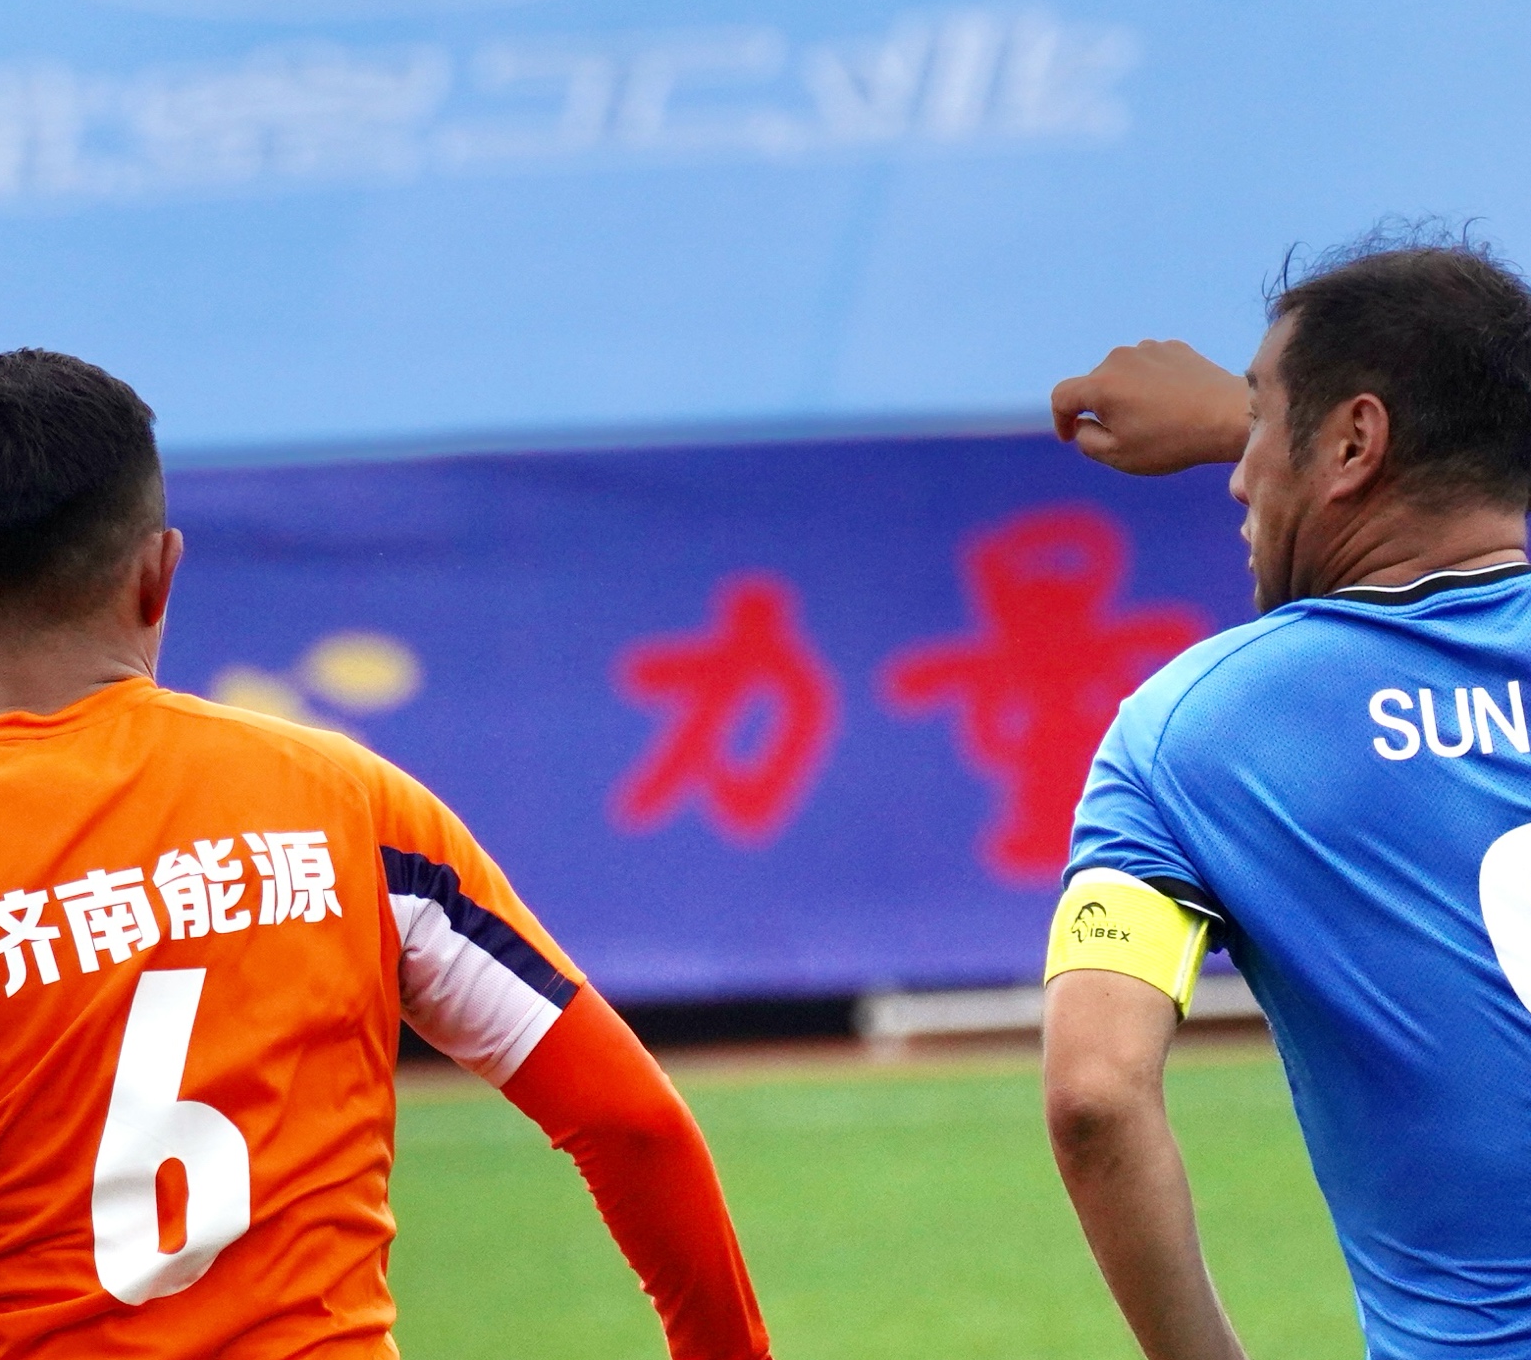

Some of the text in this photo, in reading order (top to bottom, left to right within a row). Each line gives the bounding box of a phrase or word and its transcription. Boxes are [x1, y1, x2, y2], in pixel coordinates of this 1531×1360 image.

[1369, 680, 1531, 762] SUN
[1090, 927, 1131, 943] IBEX
[91, 968, 251, 1306] 6
